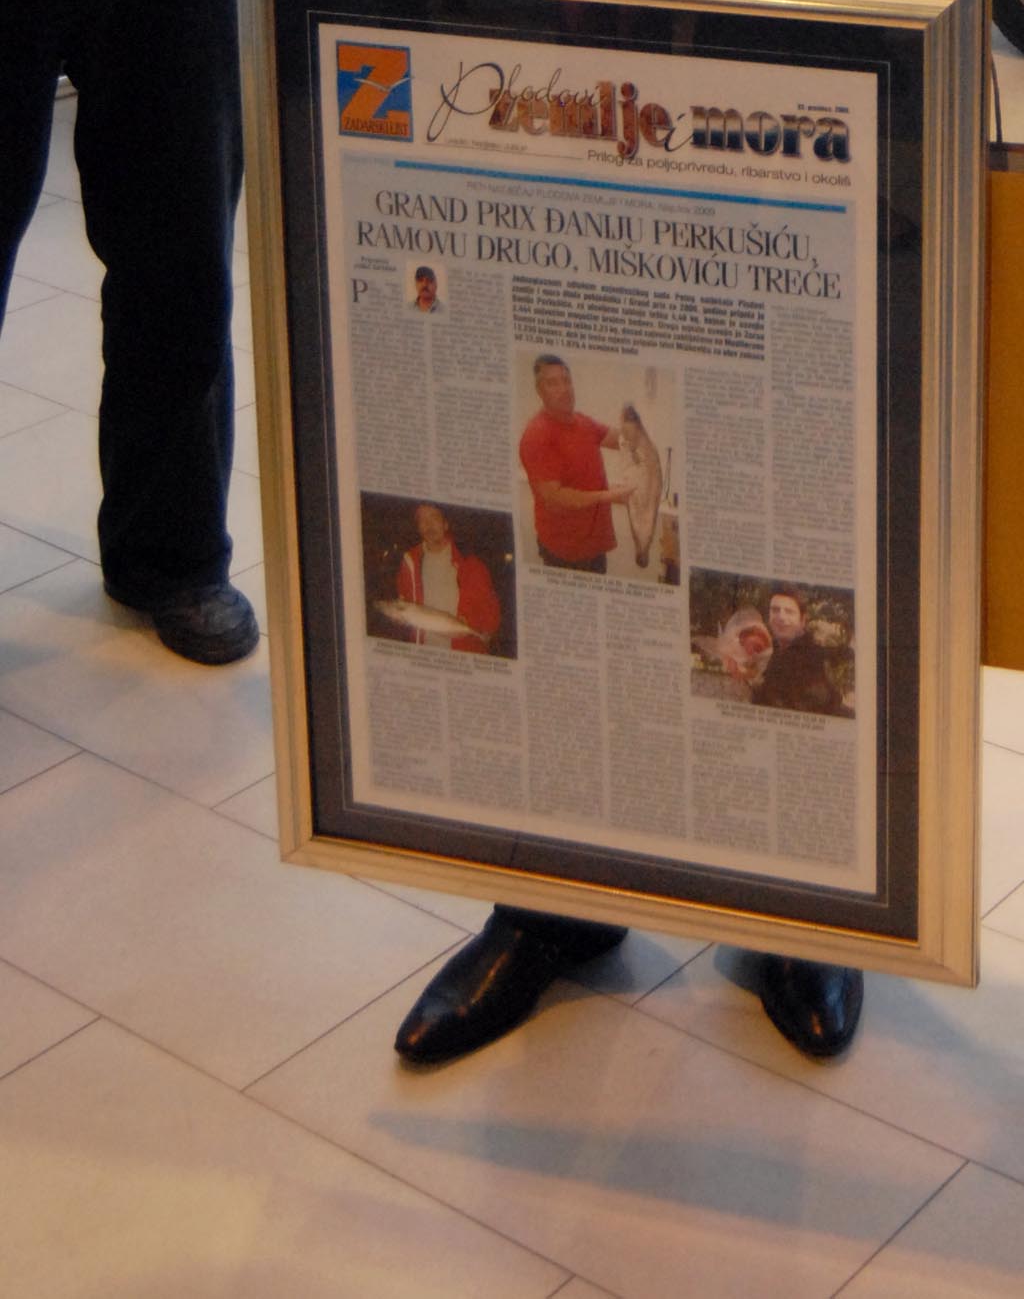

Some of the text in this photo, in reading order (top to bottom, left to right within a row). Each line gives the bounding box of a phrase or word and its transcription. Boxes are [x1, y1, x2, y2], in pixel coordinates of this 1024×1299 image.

[488, 80, 673, 159] zemlje
[689, 104, 851, 164] mora
[588, 149, 625, 167] Prilog
[356, 220, 468, 258] RAMOVU
[587, 243, 738, 289] MIŠKOVIĆU
[748, 262, 842, 300] TREĆE
[375, 189, 819, 266] GRAND PRIX ĐANIJU PERKUŠIĆU,
